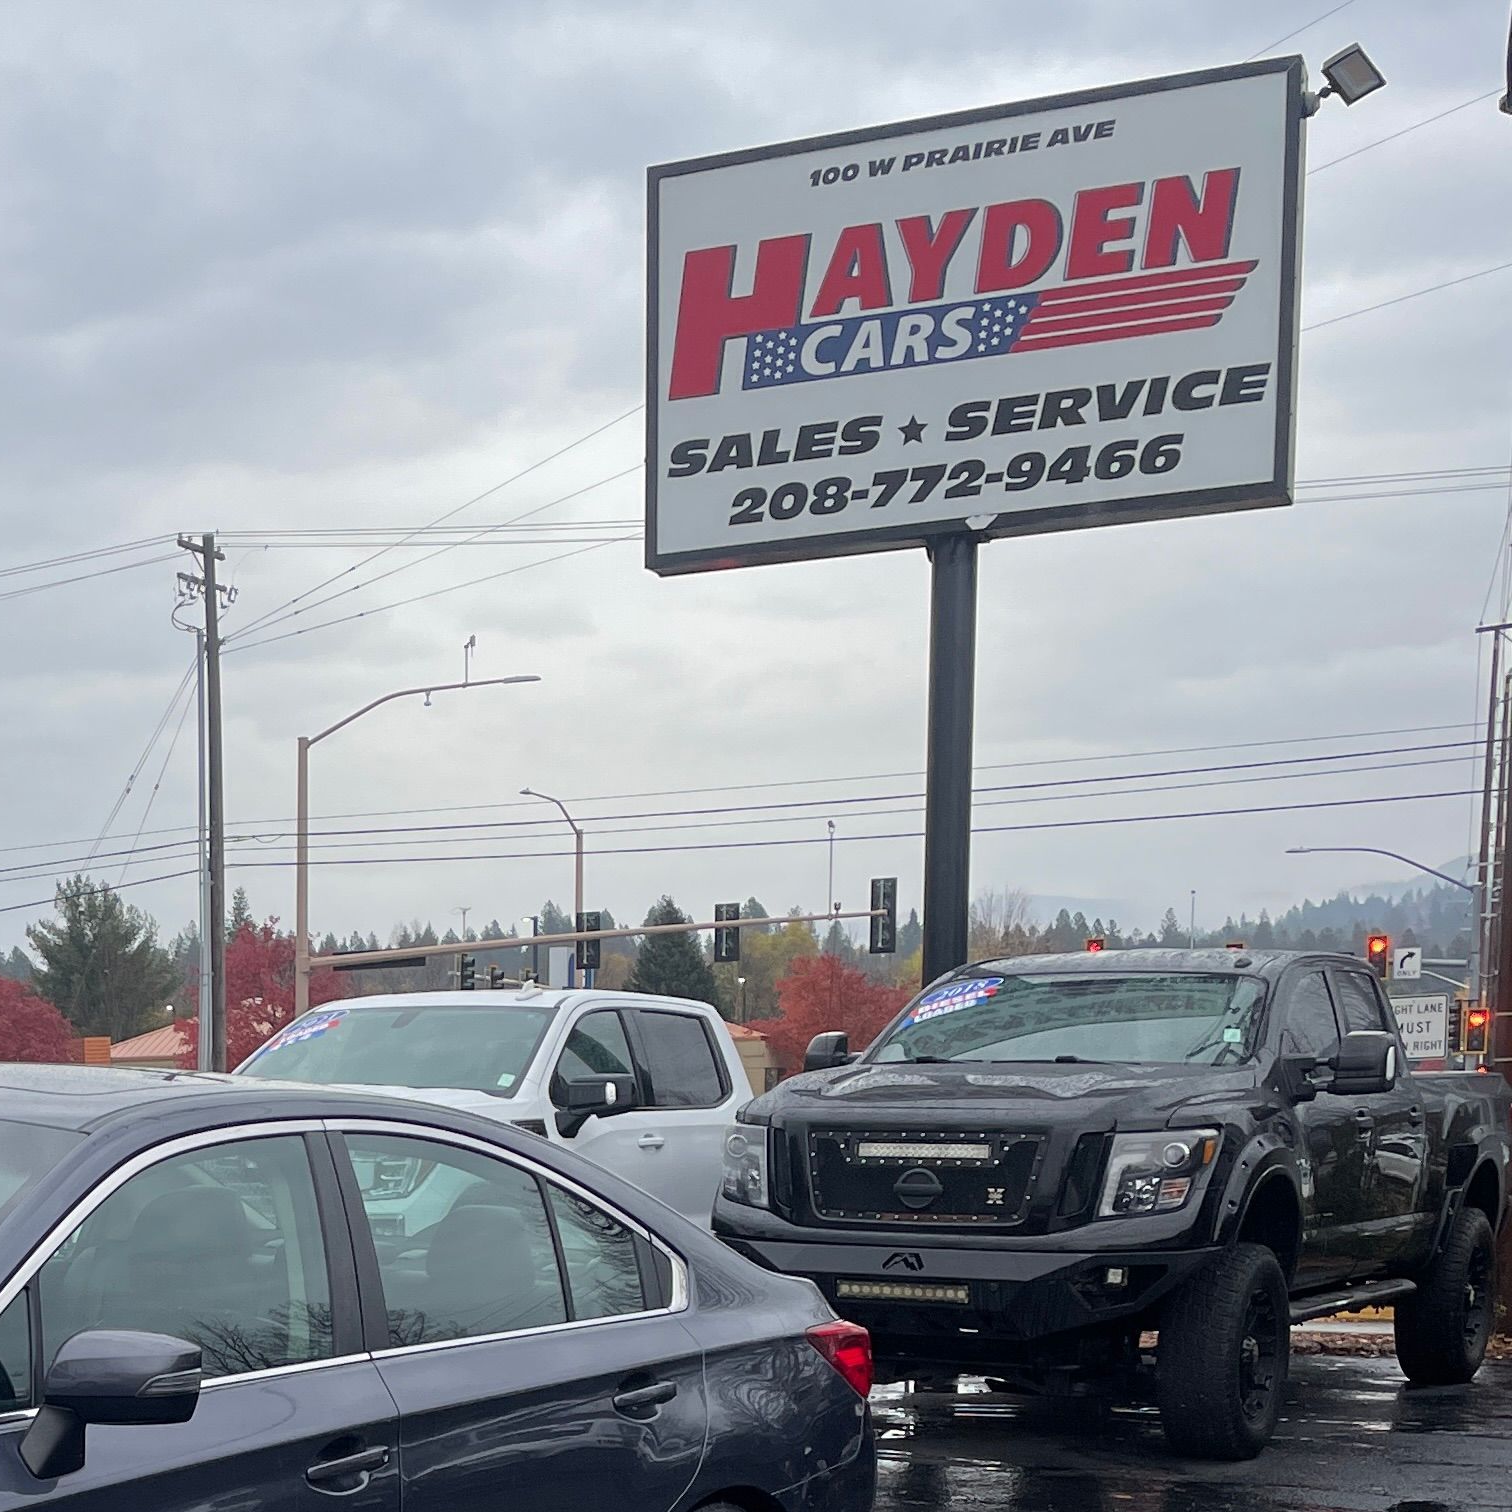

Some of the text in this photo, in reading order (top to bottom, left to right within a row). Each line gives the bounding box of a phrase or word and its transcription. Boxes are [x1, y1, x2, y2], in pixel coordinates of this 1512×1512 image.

[810, 119, 1116, 187] 100 W PRAIRIE AVE
[668, 167, 1241, 401] HAYDEN
[799, 305, 976, 377] CARS
[667, 362, 1271, 478] SALES SERVICE
[728, 433, 1185, 526] 208-772-9466
[1392, 1003, 1443, 1015] GHT LANE
[1413, 1040, 1442, 1052] RIGHT
